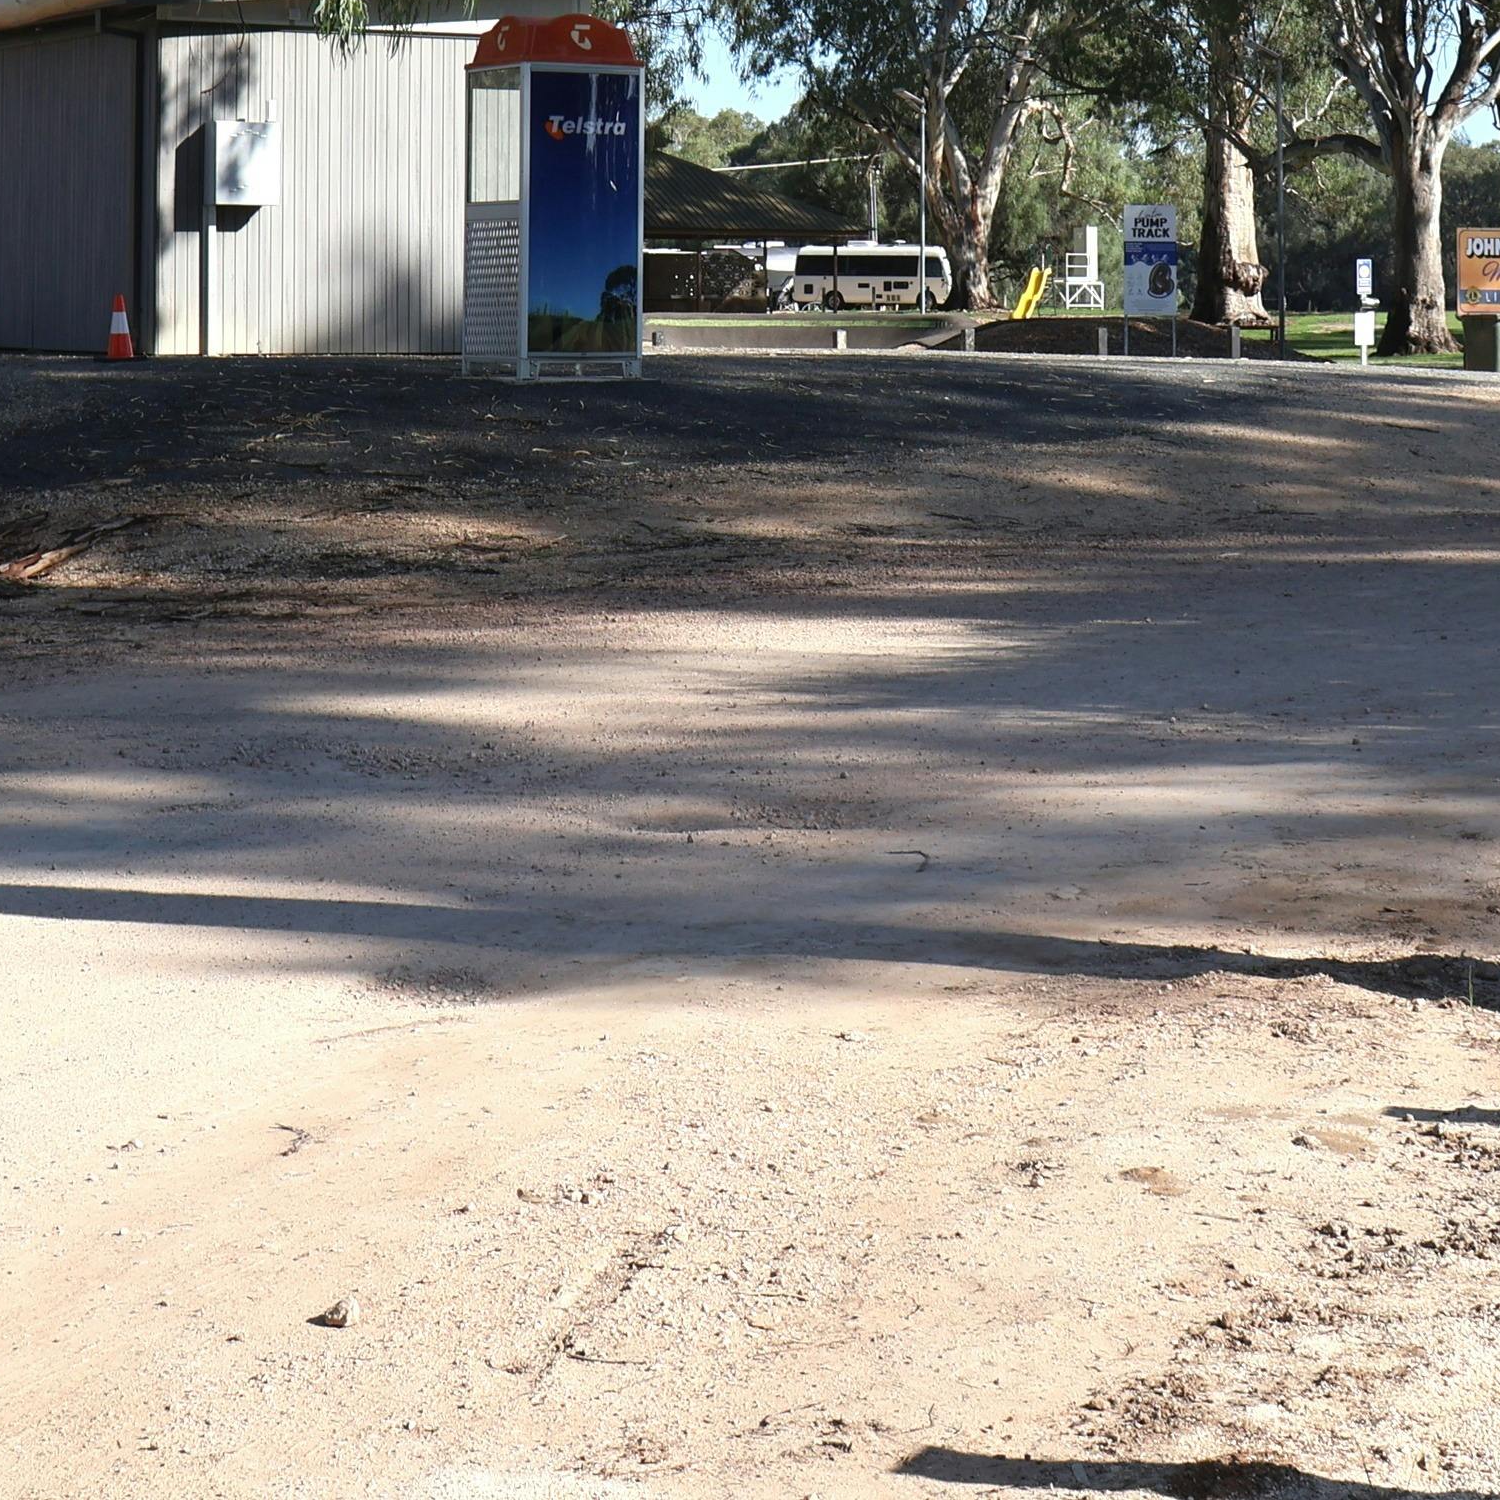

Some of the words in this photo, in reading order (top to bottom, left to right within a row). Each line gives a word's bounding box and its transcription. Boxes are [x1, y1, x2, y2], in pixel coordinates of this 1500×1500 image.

[548, 115, 627, 135] Telstra
[1134, 217, 1168, 228] PUMP
[1131, 227, 1170, 238] TRACK
